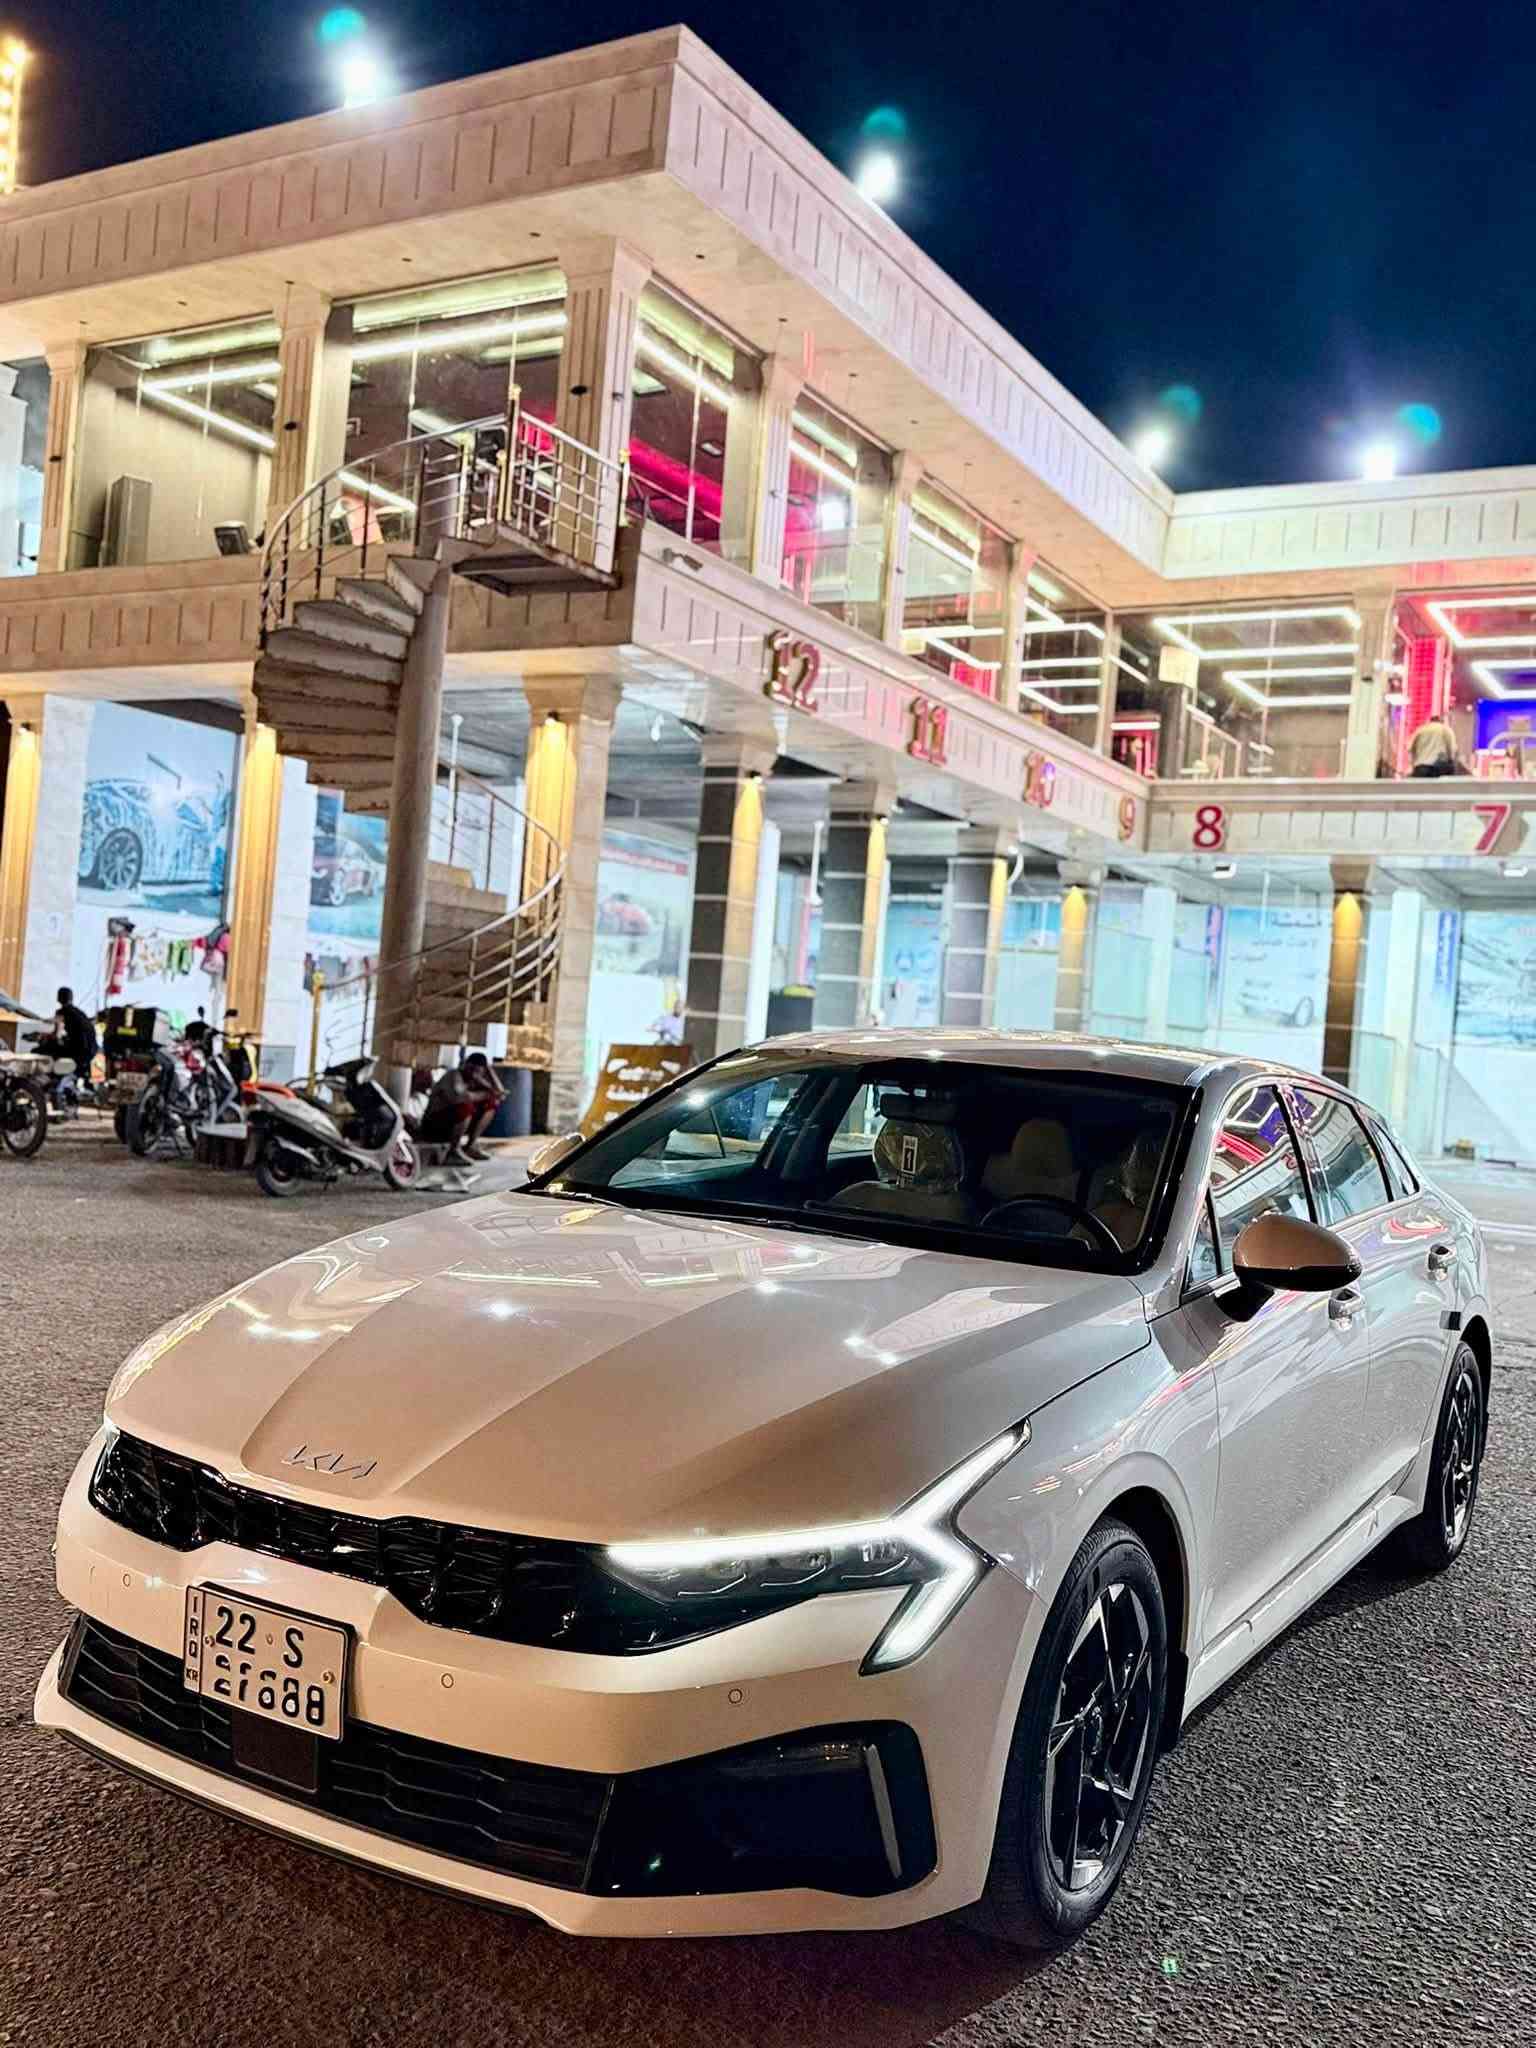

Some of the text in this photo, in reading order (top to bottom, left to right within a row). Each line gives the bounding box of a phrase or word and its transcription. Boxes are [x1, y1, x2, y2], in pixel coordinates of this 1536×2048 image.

[763, 631, 820, 714] 12
[907, 695, 949, 767] 11
[1022, 749, 1057, 808] 10
[1118, 795, 1137, 840] 9
[1193, 804, 1224, 849] 8
[1472, 803, 1511, 852] 7
[281, 1445, 379, 1480] KIA
[215, 1605, 304, 1668] 22 S
